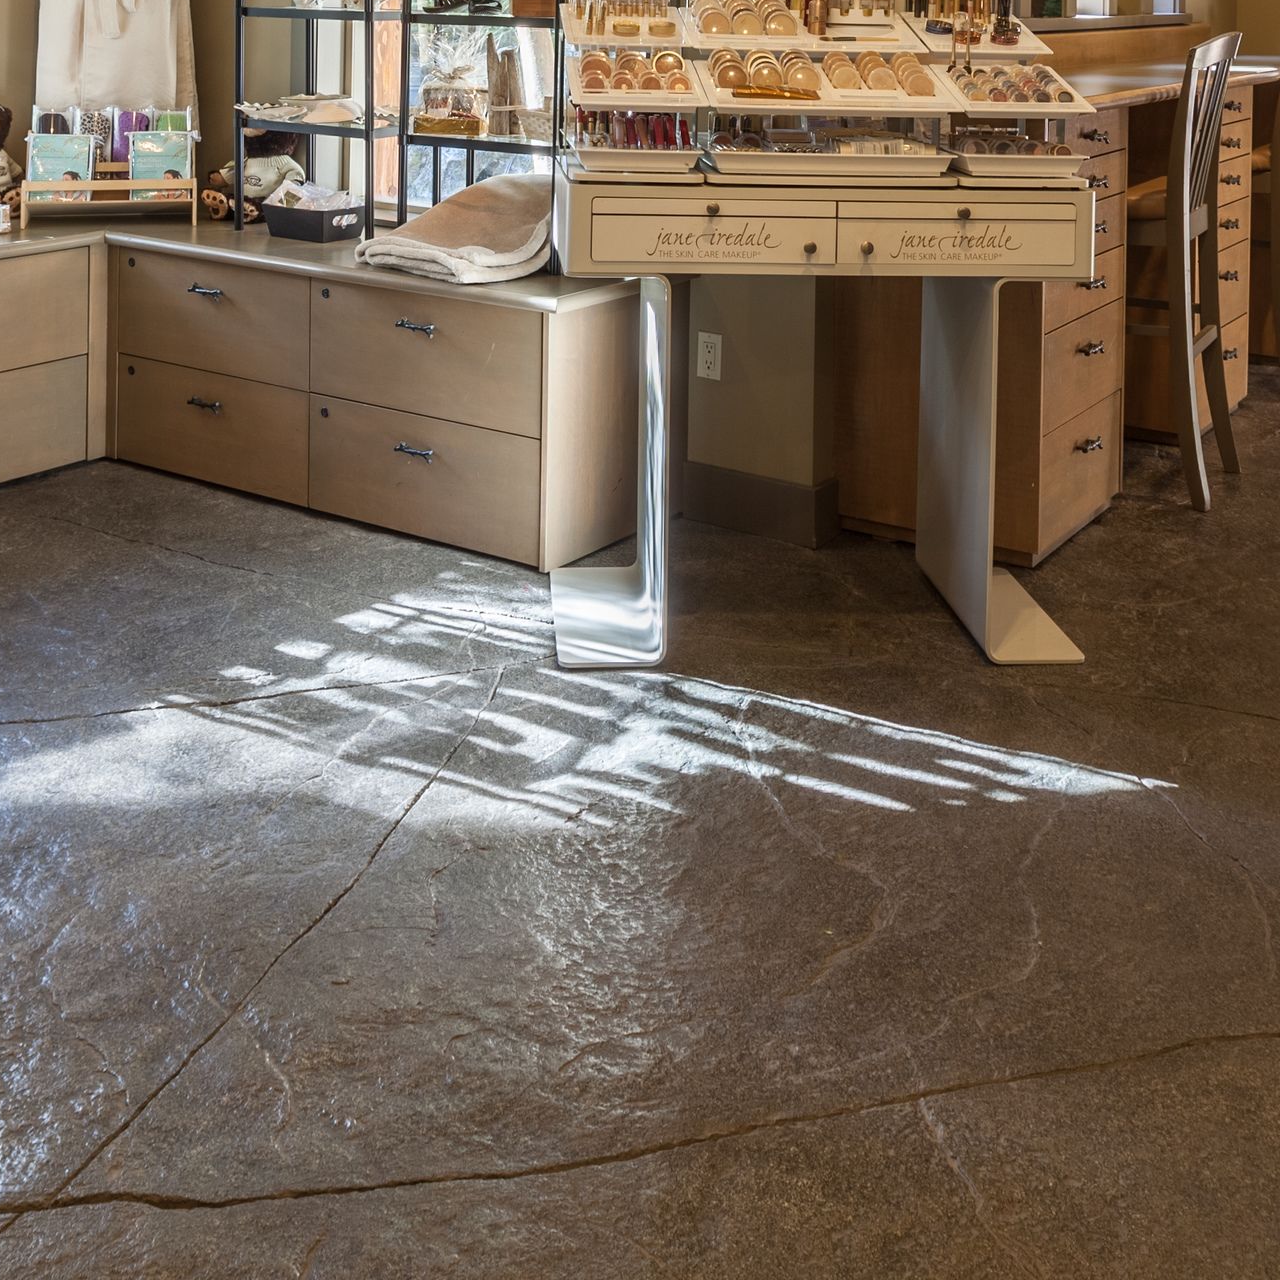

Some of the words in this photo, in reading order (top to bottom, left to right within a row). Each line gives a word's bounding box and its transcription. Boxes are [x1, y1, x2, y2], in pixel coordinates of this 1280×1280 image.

[646, 227, 695, 256] jane
[695, 222, 782, 249] iredale
[889, 230, 939, 259] jane
[938, 225, 1023, 251] iredale
[658, 249, 673, 258] THE
[675, 250, 694, 258] SKIN
[697, 250, 719, 258] CARE
[902, 252, 917, 260] THE
[918, 252, 937, 260] SKIN
[940, 252, 962, 260] CARE
